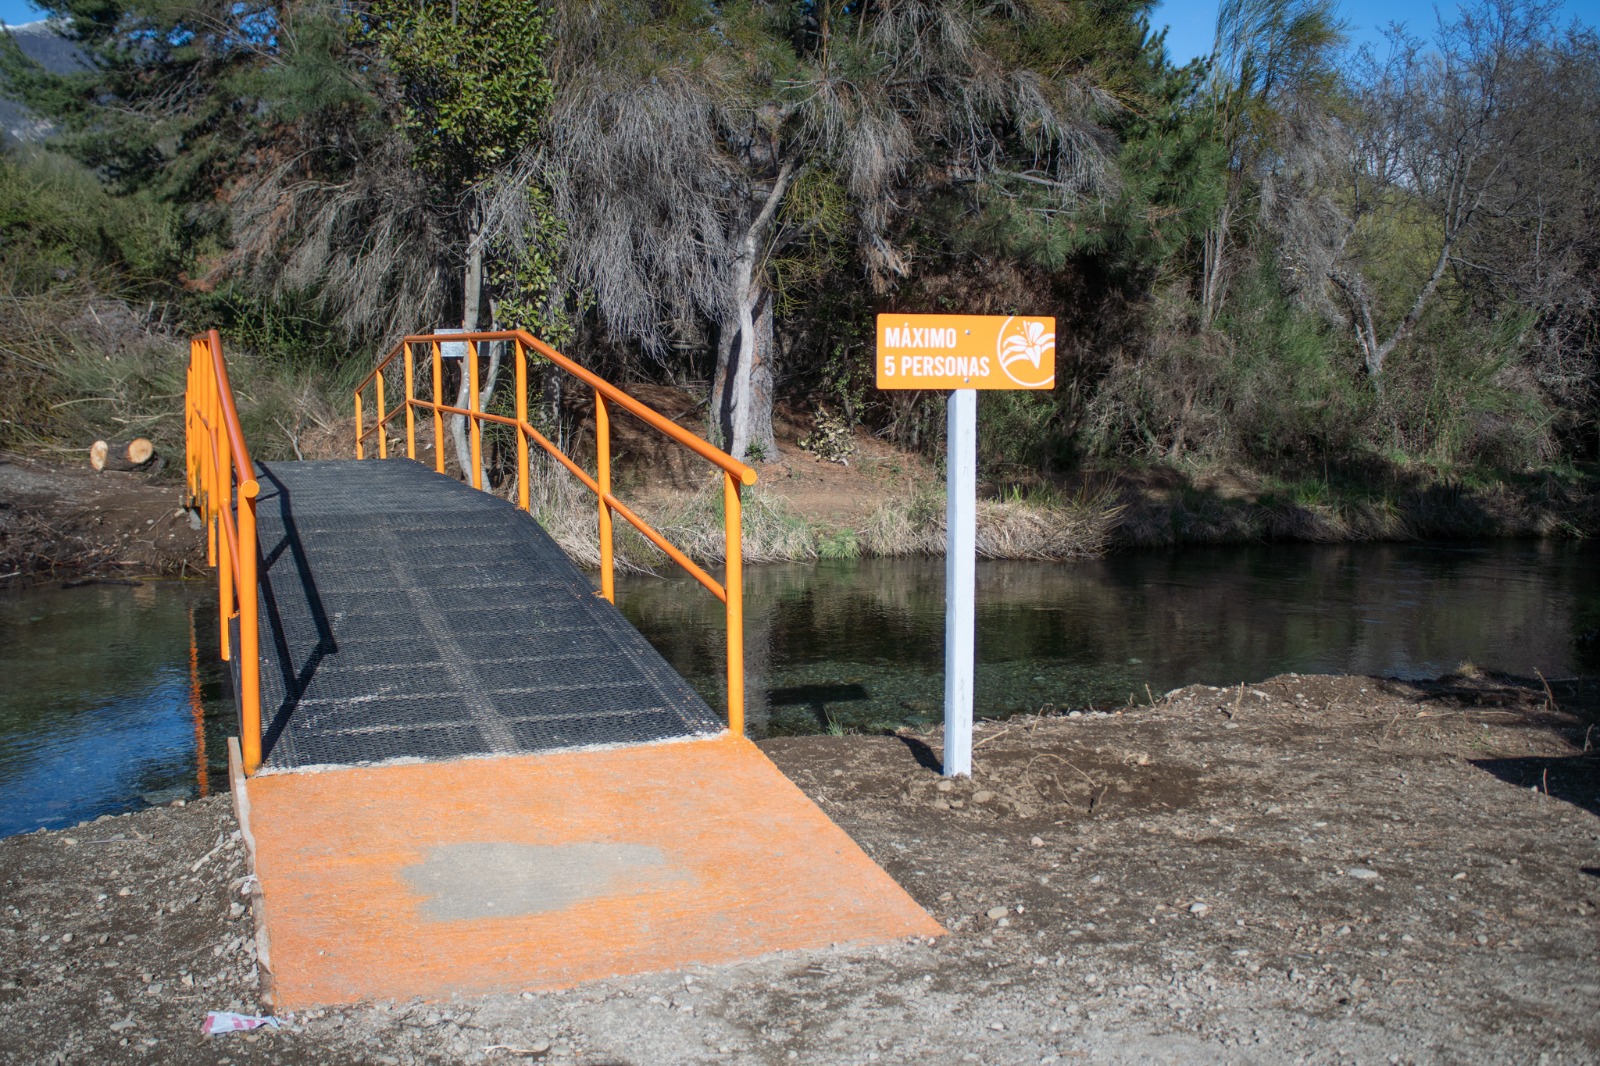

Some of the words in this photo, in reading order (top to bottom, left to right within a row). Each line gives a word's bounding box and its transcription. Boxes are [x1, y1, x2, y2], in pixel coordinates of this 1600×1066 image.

[884, 322, 957, 349] MÁXIMO
[884, 355, 896, 377] 5
[901, 355, 990, 377] PERSONAS
